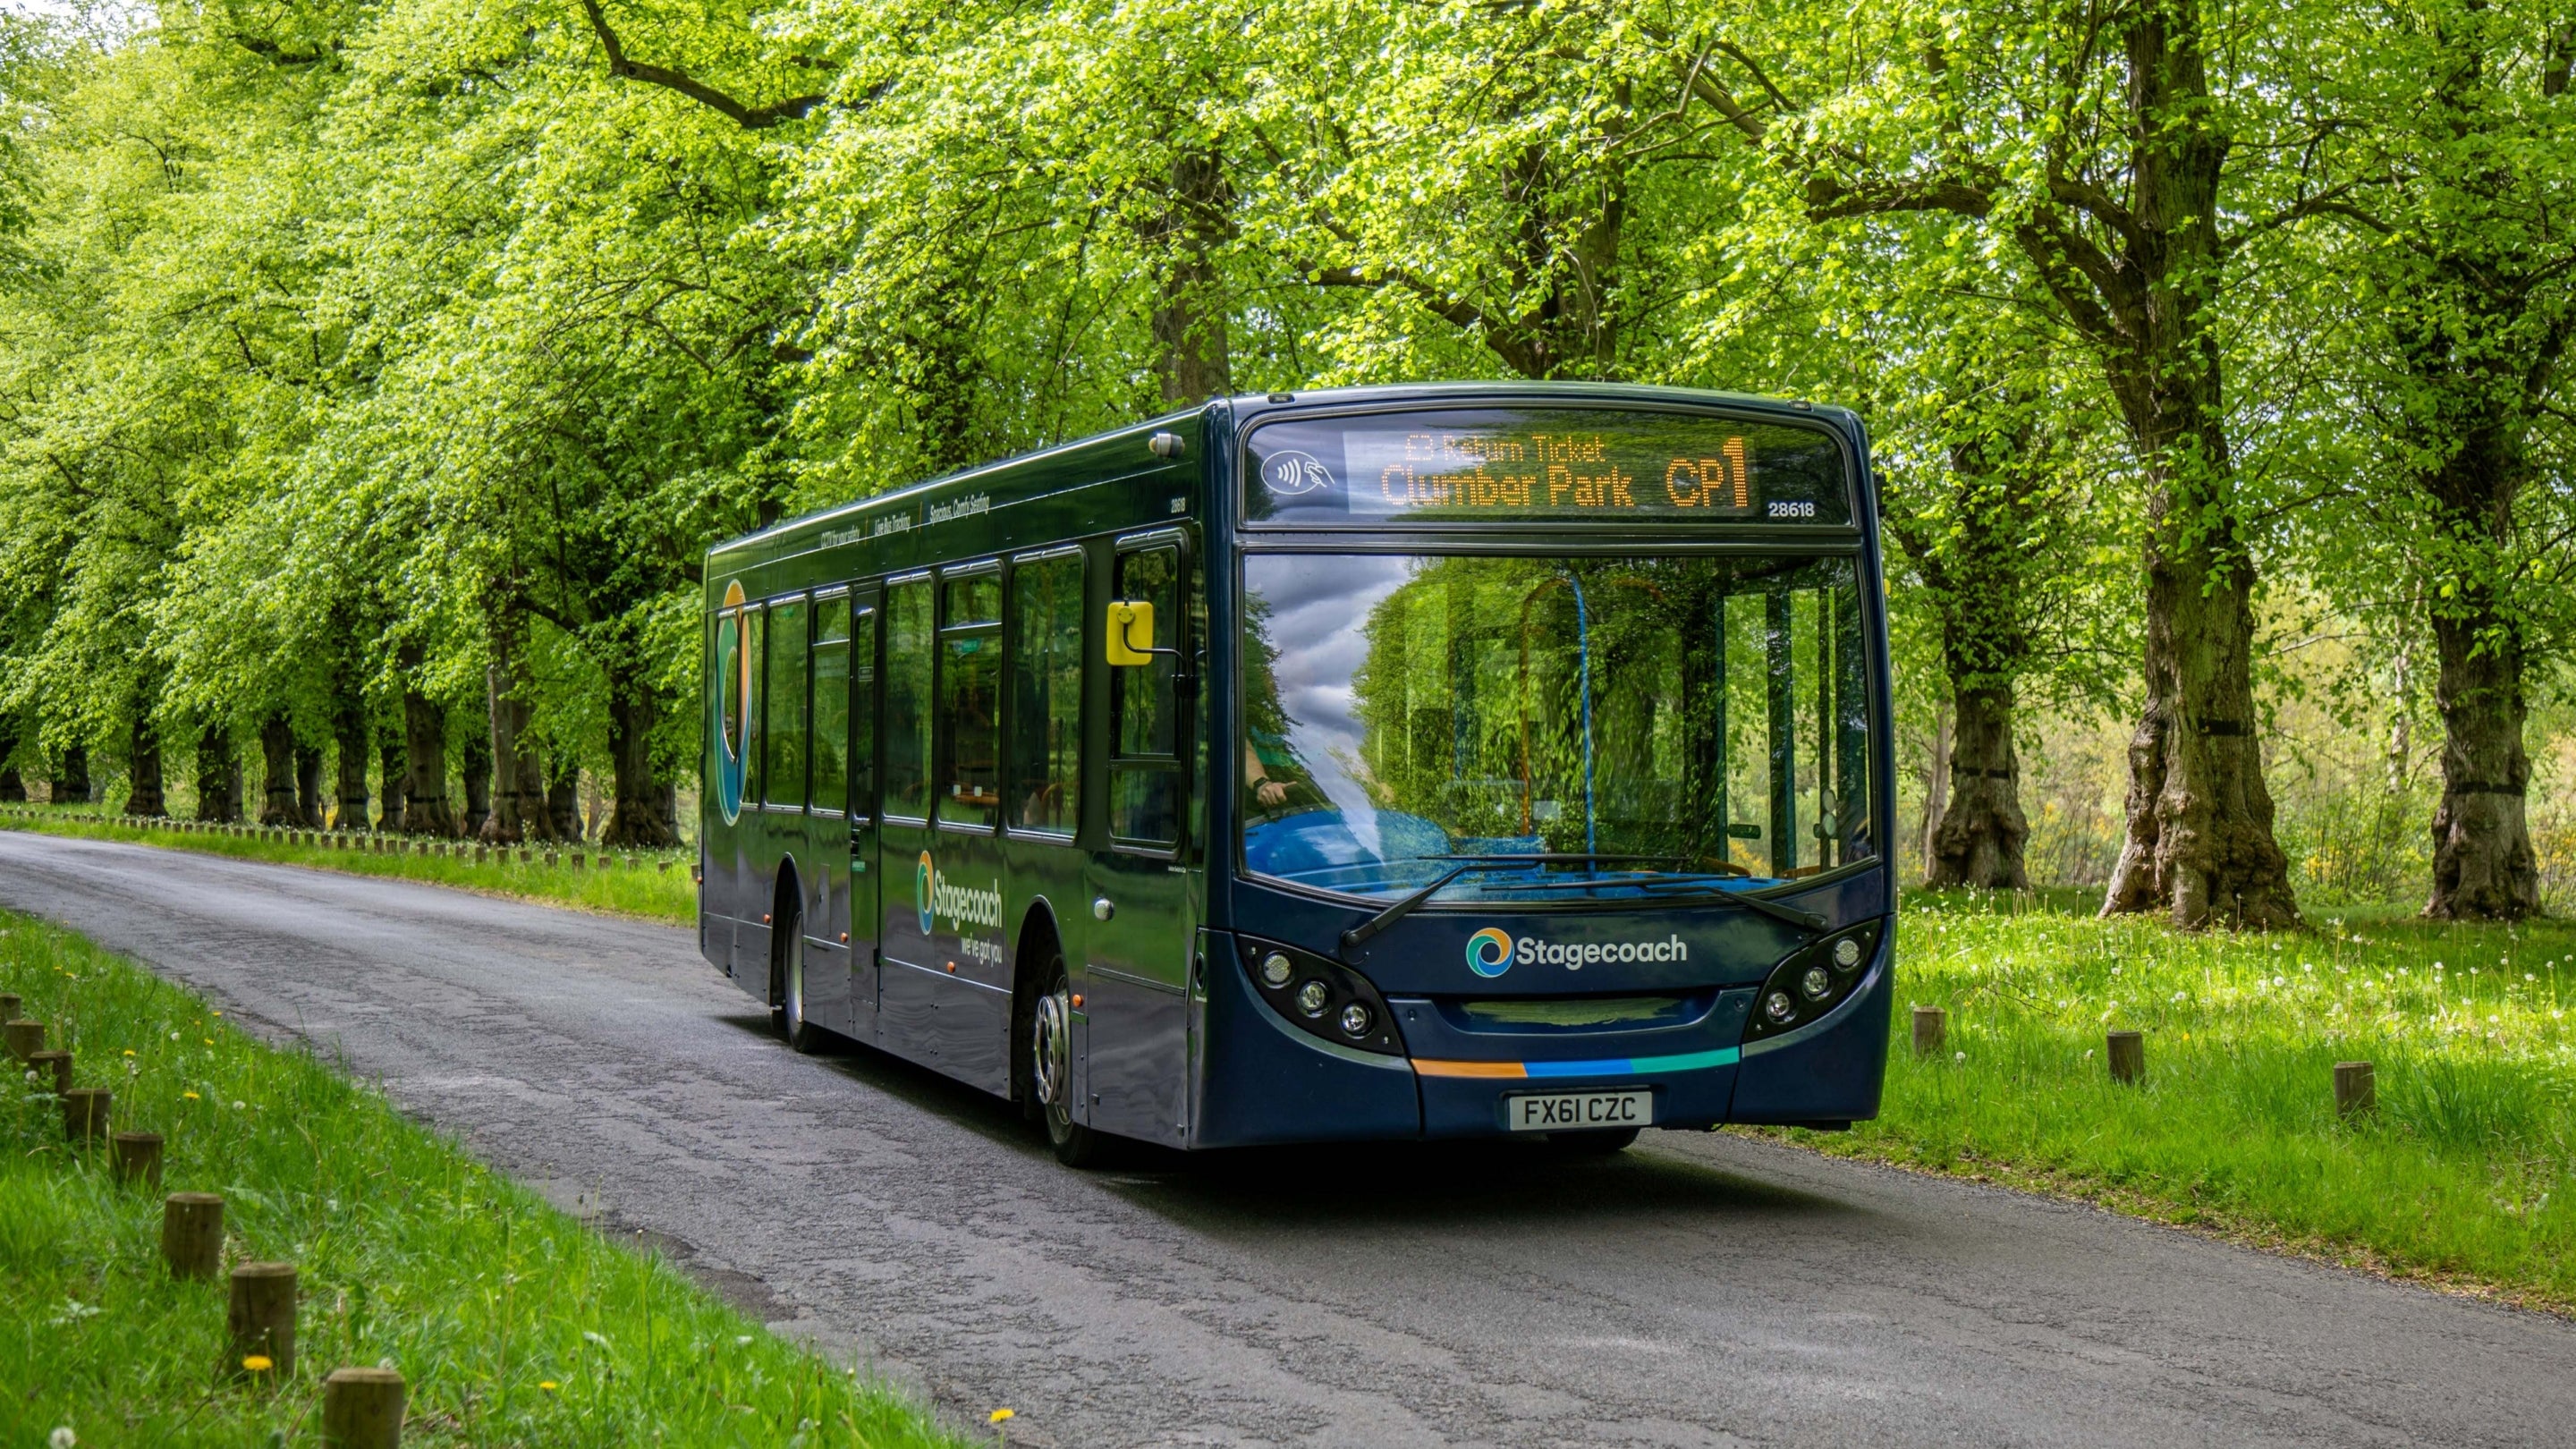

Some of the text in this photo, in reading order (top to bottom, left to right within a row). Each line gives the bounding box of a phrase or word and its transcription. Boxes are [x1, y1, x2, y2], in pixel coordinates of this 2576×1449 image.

[1443, 434, 1524, 462] Return
[1531, 435, 1607, 462] Ticket
[1381, 463, 1636, 507] Clumber Park
[1665, 436, 1749, 508] CP1
[1767, 502, 1816, 518] 28618
[935, 869, 1002, 931] Stagecoach
[961, 931, 1002, 968] we've got you
[1516, 934, 1688, 970] Stagecoach
[1524, 1097, 1636, 1124] FX61 CZC
